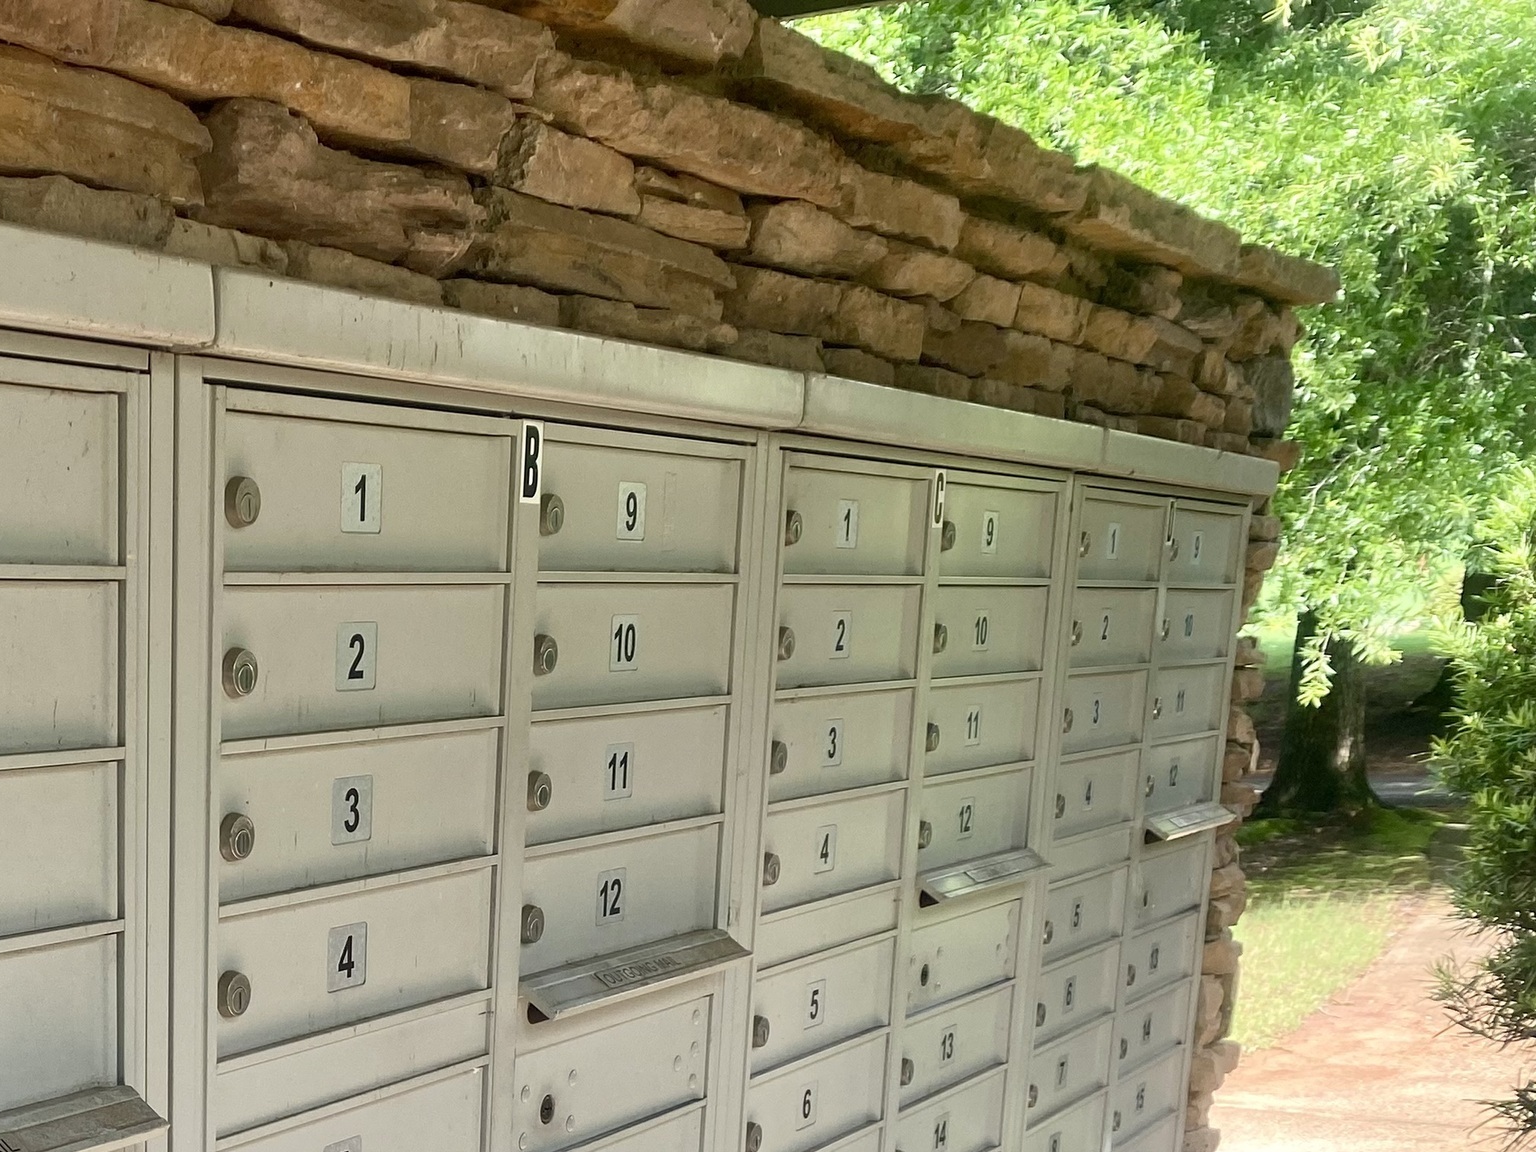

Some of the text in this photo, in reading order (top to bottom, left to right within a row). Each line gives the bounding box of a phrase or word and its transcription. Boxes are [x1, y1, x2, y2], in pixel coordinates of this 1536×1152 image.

[523, 425, 540, 498] B
[354, 474, 367, 522] 1
[625, 491, 638, 532] 9
[934, 472, 944, 524] C
[986, 517, 994, 547] 9
[1193, 535, 1200, 559] 9
[615, 624, 635, 662] 10
[835, 618, 846, 652] 2
[974, 616, 988, 646] 10
[1101, 615, 1109, 641] 2
[348, 634, 364, 679] 2
[1092, 699, 1100, 725] 3
[1175, 689, 1186, 713] 11
[967, 710, 980, 740] 11
[827, 726, 837, 759] 3
[609, 752, 628, 790] 11
[1085, 781, 1092, 806] 4
[345, 788, 359, 832] 3
[958, 804, 972, 834] 12
[819, 833, 830, 865] 4
[600, 879, 621, 917] 12
[1073, 903, 1081, 928] 5
[338, 936, 354, 978] 4
[603, 956, 681, 984] OUTGOING MAIL
[809, 988, 820, 1020] 5
[1065, 981, 1073, 1006] 6
[941, 1032, 954, 1061] 13
[1058, 1060, 1067, 1085] 7
[802, 1088, 812, 1119] 6
[934, 1120, 947, 1150] 14
